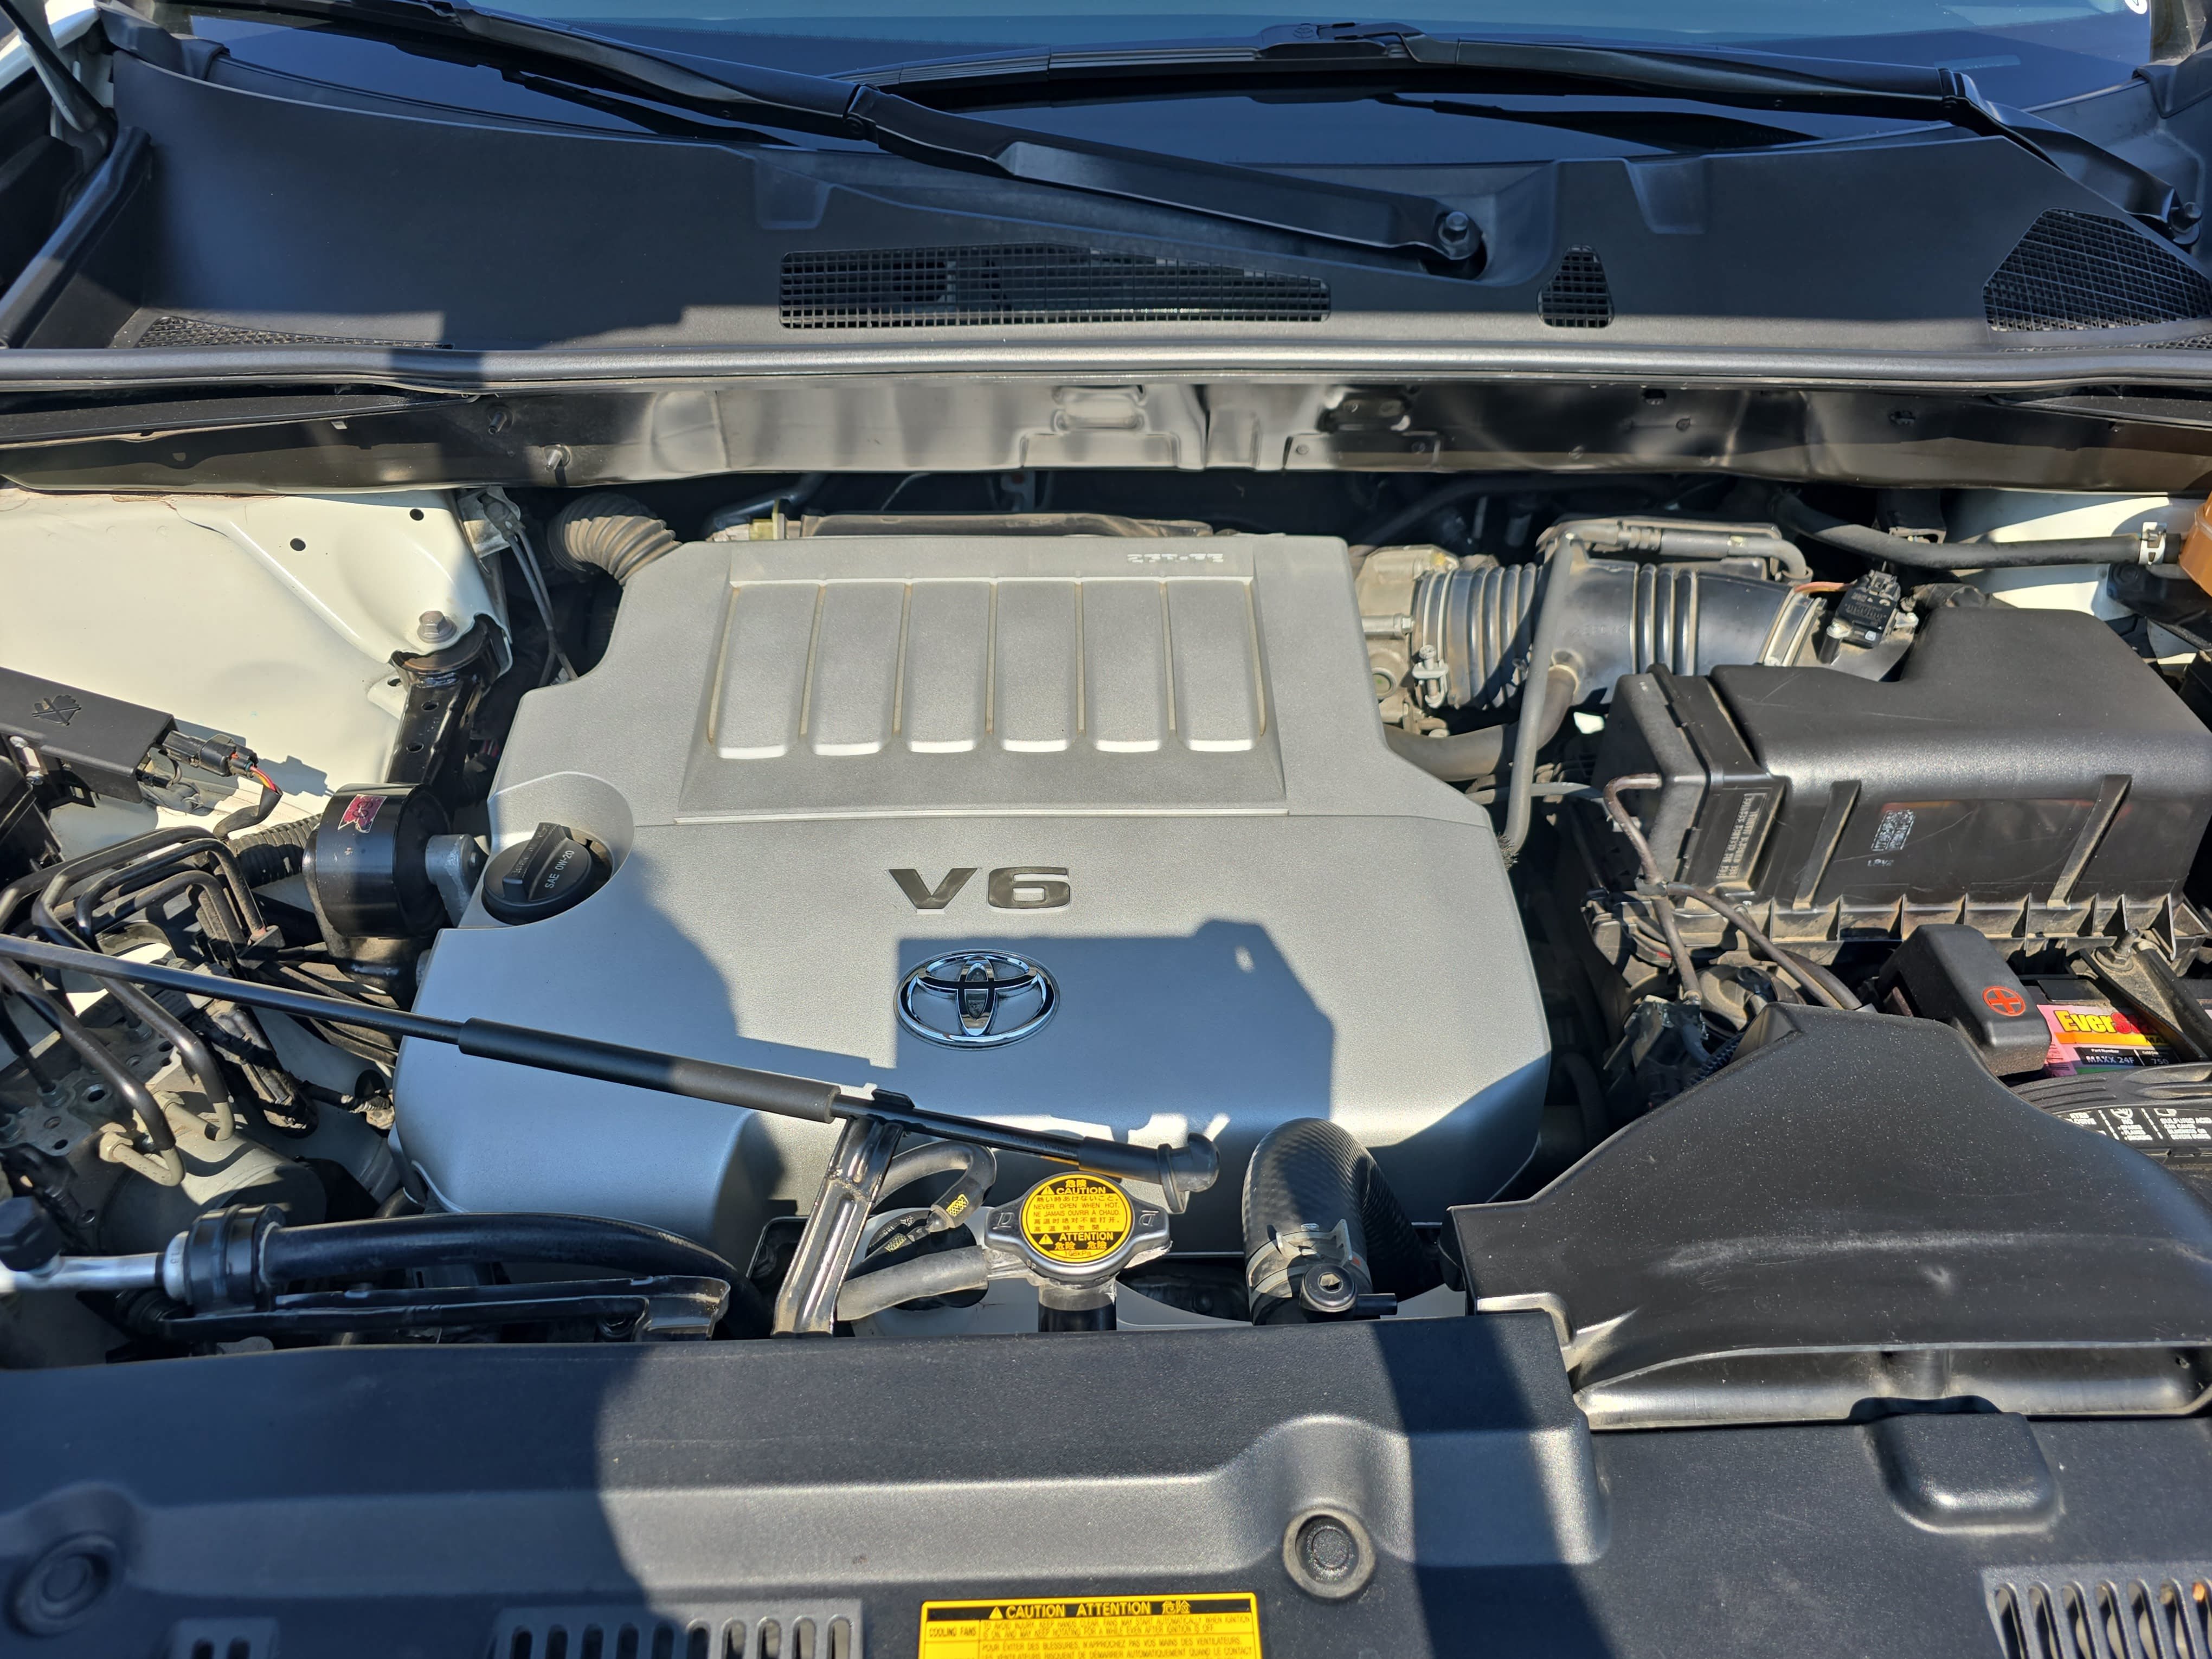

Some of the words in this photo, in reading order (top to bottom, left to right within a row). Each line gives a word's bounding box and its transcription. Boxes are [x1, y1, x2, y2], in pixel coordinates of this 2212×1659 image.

[545, 873, 560, 889] SAE
[555, 850, 575, 871] 0W-20
[886, 866, 1071, 915] V6
[2086, 1056, 2117, 1064] MAXX
[2117, 1056, 2135, 1064] 24F
[1059, 1232, 1114, 1241] ATTENTION
[1006, 1604, 1066, 1618] CAUTION
[1076, 1600, 1151, 1617] ATTENTION
[929, 1627, 957, 1637] COOLING
[960, 1626, 976, 1636] FANS
